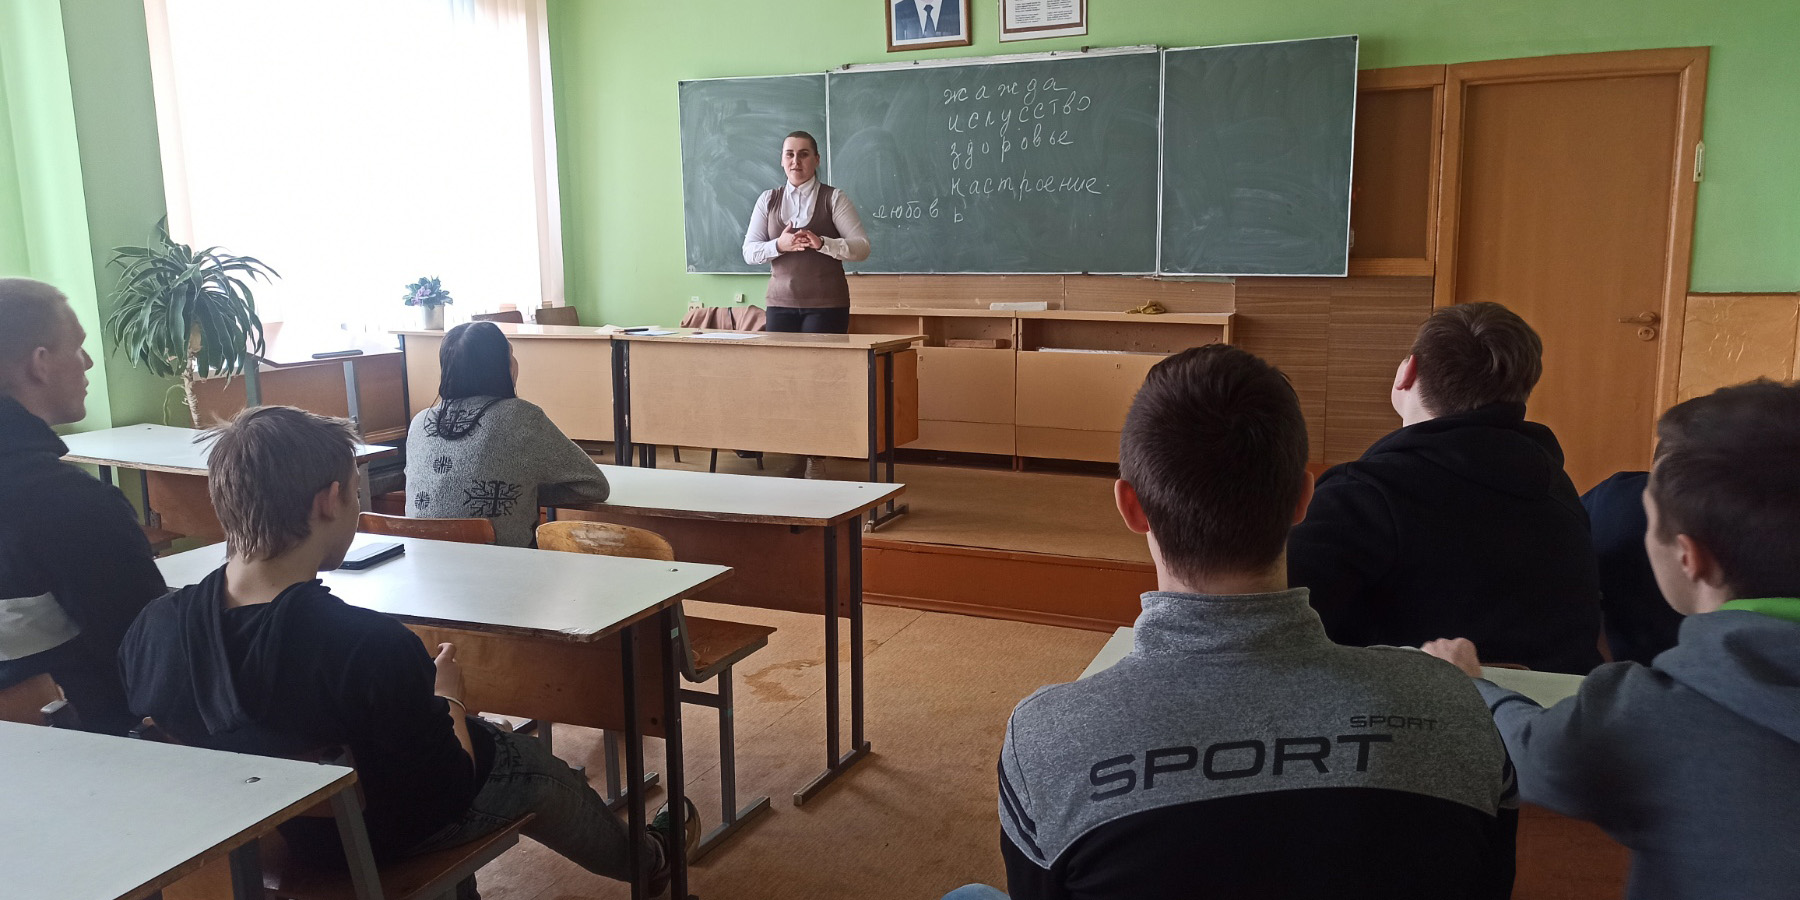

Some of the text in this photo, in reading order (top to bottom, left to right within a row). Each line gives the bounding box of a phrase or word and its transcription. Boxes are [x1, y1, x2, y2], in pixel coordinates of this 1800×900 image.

[944, 77, 1068, 106] жажда
[950, 123, 1074, 170] здоровье
[1349, 714, 1439, 732] SPORT
[1089, 733, 1394, 801] SPORT
